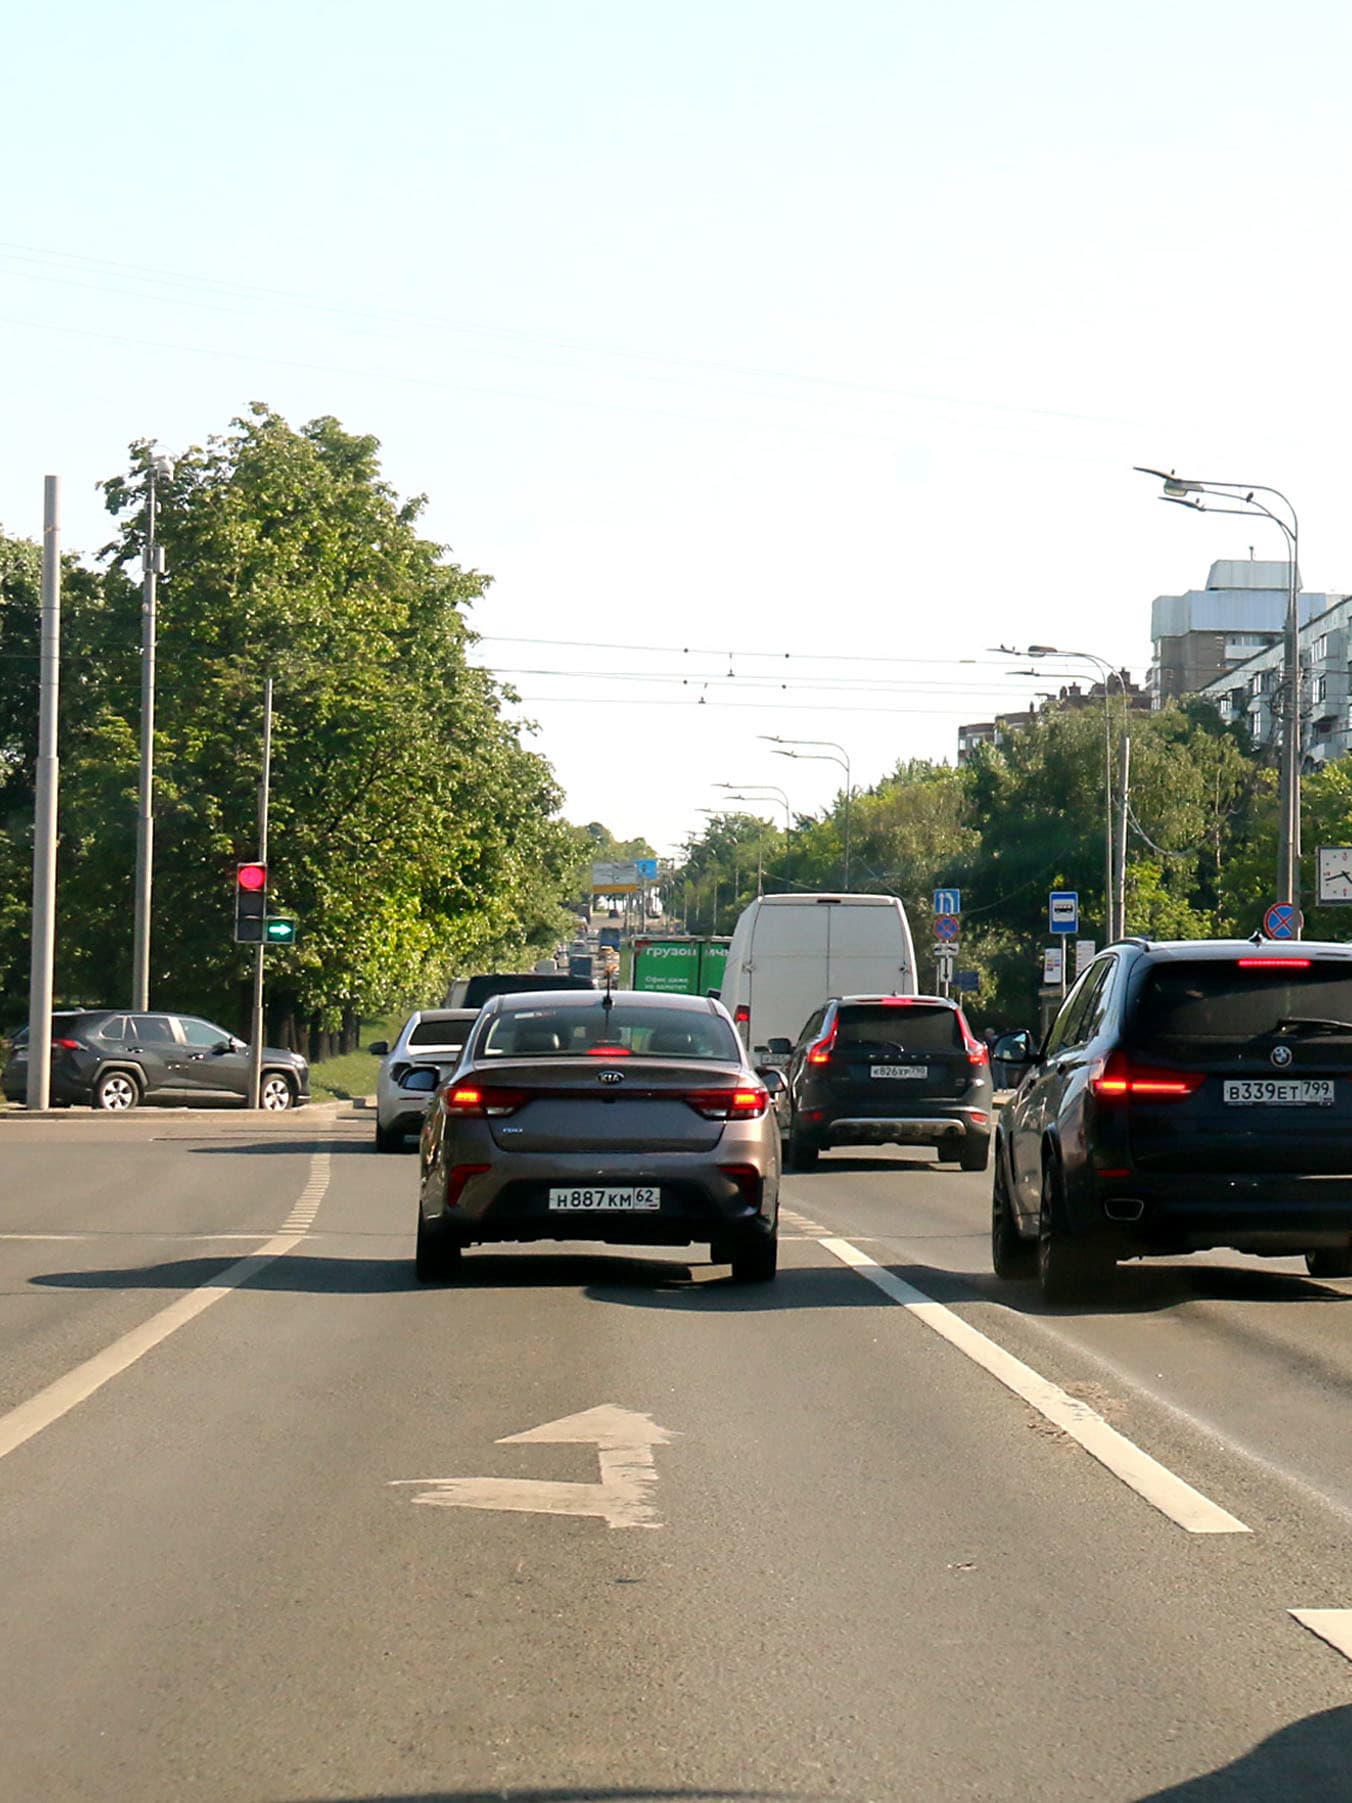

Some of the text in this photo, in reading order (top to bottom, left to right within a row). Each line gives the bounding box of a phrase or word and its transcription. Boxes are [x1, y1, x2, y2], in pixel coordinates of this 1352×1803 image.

[600, 1071, 620, 1083] KIA
[1229, 1081, 1330, 1101] В339ЕТ 799
[557, 1189, 654, 1208] Н887КМ 62
